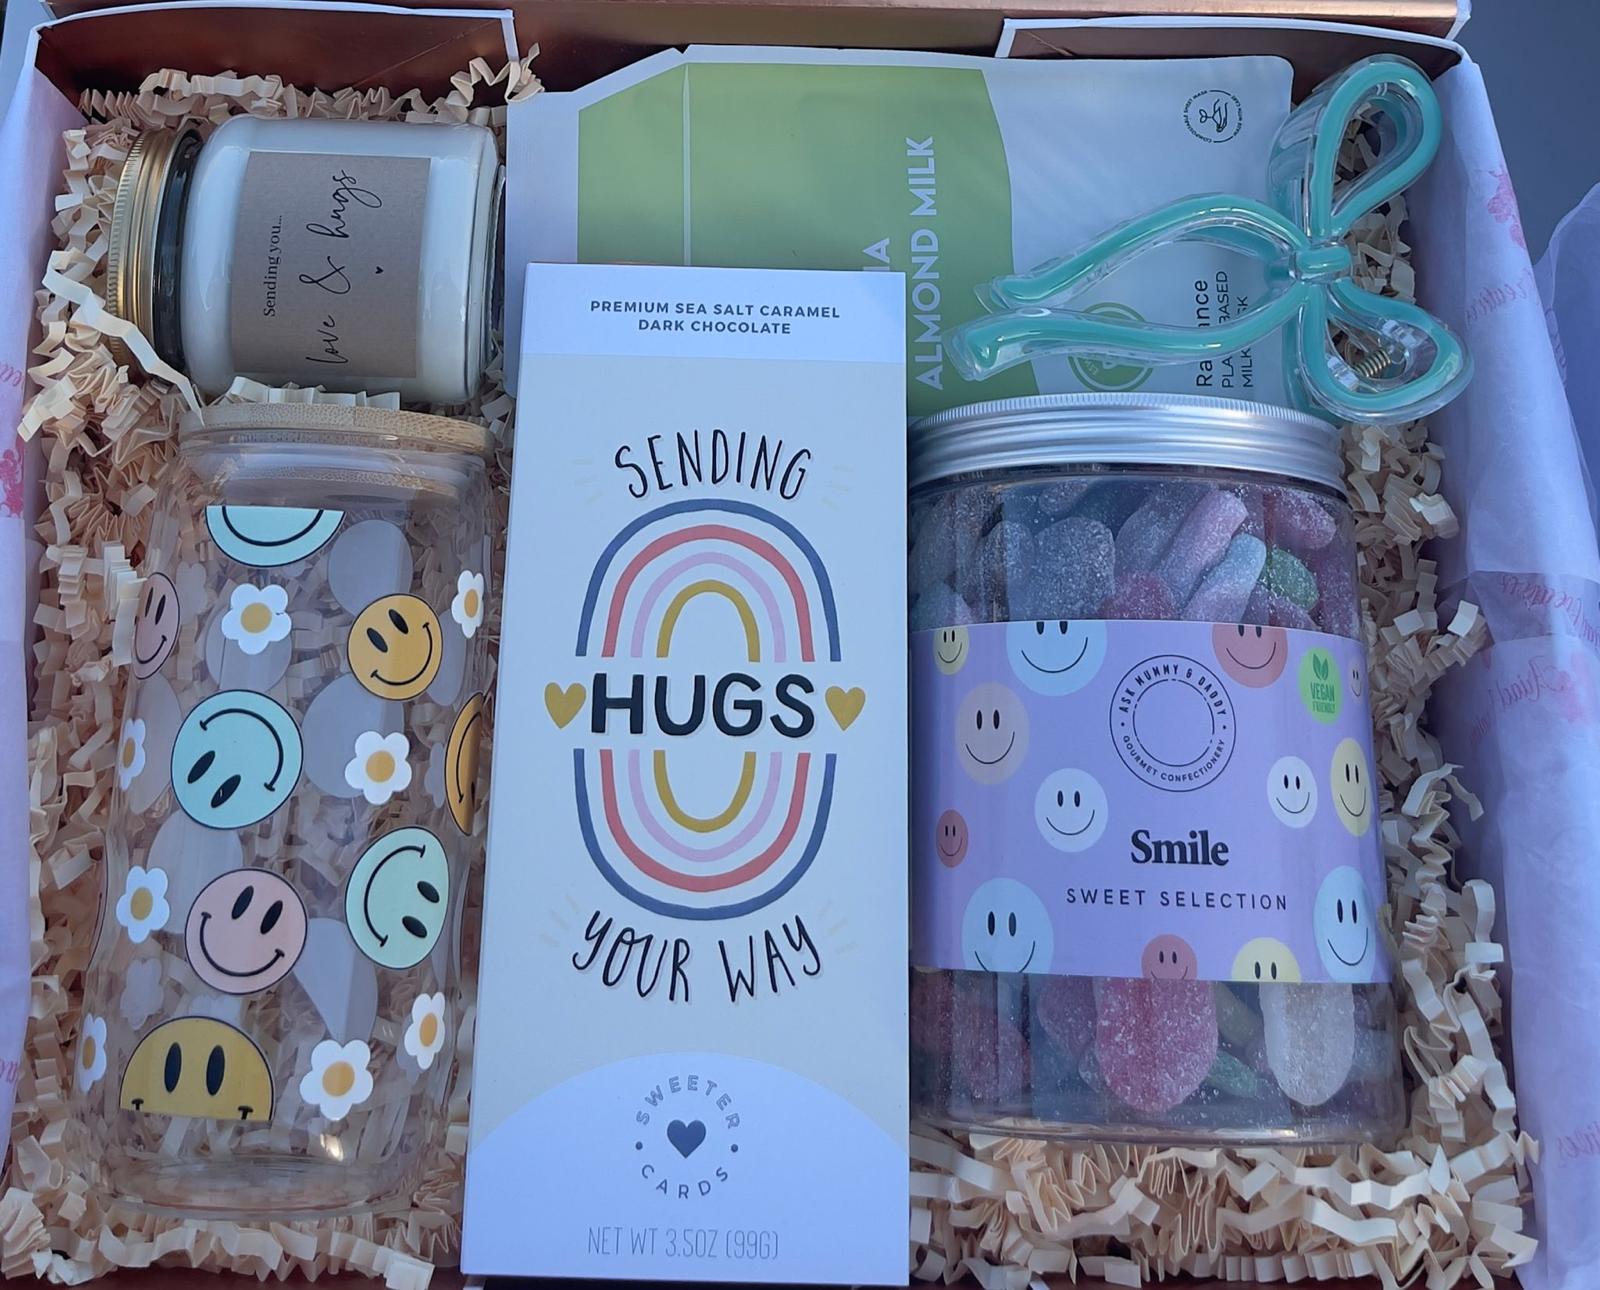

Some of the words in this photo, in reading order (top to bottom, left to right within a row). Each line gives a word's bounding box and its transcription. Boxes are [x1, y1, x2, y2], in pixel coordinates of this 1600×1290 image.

[906, 136, 937, 216] MILK
[306, 169, 382, 238] hugs
[270, 215, 282, 254] you...
[263, 256, 282, 317] Sending
[299, 255, 350, 295] &
[590, 300, 669, 314] PREMIUM
[675, 302, 707, 315] SEA
[713, 303, 754, 316] SALT
[760, 305, 840, 318] CARAMEL
[638, 319, 684, 331] DARK
[691, 320, 791, 335] CHOCOLATE
[911, 229, 944, 391] ALMOND
[1194, 280, 1213, 387] Rance
[305, 315, 348, 364] love
[1238, 348, 1254, 388] MILK
[614, 429, 812, 500] SENDING
[590, 672, 815, 738] HUGS
[1118, 687, 1136, 714] ASK
[1185, 667, 1193, 679] &
[1197, 675, 1227, 716] DADDY
[1310, 681, 1335, 702] VEGAN
[1122, 734, 1159, 777] GOURMET
[1159, 738, 1225, 783] CONFECTIONERY
[1130, 829, 1230, 866] Smile
[1066, 888, 1146, 906] SWEET
[1159, 891, 1287, 911] SELECTION
[572, 910, 691, 1002] YOUR
[717, 915, 821, 1002] WAY
[635, 1074, 741, 1130] SWEETER
[641, 1164, 729, 1199] CARDS
[588, 1227, 624, 1255] NET
[630, 1228, 659, 1256] WT
